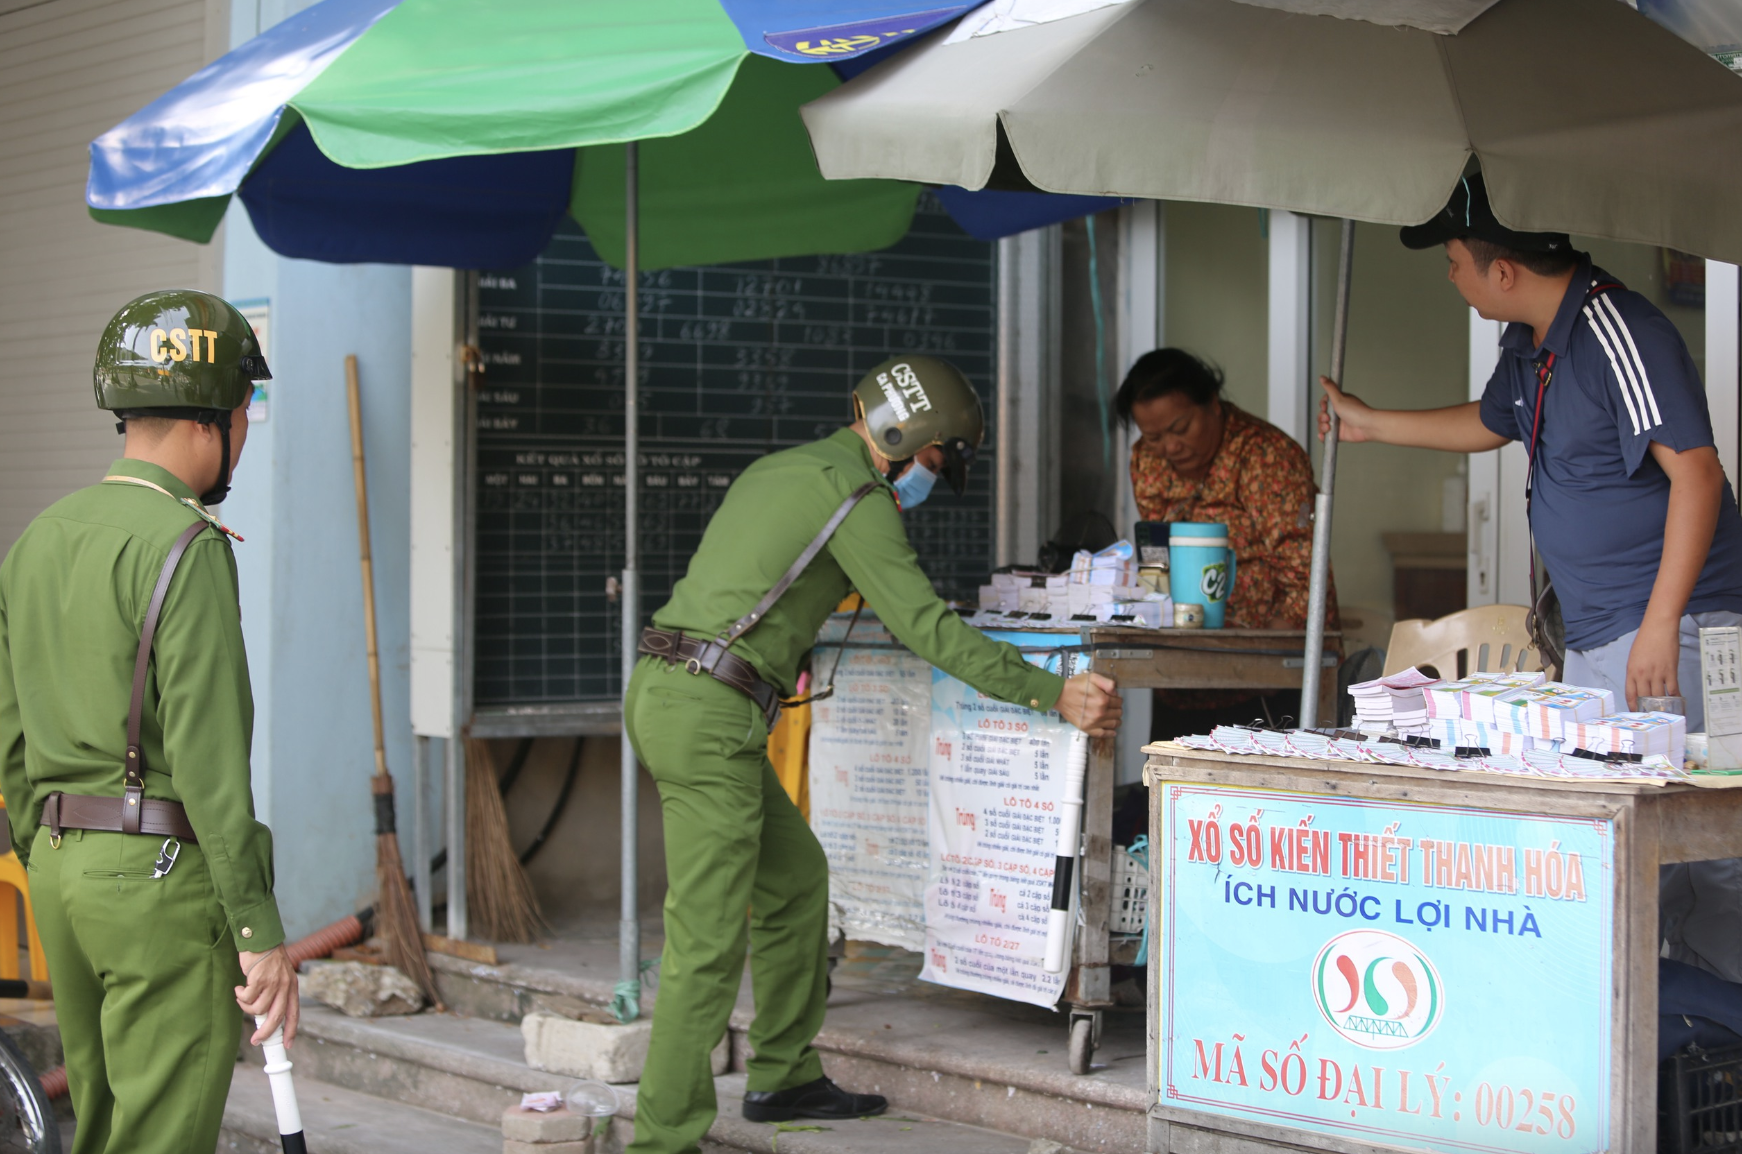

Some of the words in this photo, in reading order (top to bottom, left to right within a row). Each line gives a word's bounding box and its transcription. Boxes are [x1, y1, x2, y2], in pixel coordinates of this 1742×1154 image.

[150, 328, 218, 363] CSTT
[891, 363, 932, 413] CSTT
[1202, 568, 1226, 599] C2
[978, 718, 990, 729] LÔ
[993, 719, 1006, 730] TÔ
[1007, 721, 1013, 730] 3
[1003, 796, 1017, 806] LÔ
[1019, 798, 1032, 809] TÔ
[1034, 801, 1040, 809] 4
[1188, 804, 1222, 863] XỔ
[1229, 809, 1263, 868] SỐ
[1270, 815, 1331, 875] KIẾN
[1338, 822, 1413, 883] THIẾT
[1419, 839, 1516, 894] THANH
[1524, 841, 1586, 901] HÓA
[1225, 874, 1275, 908] ÍCH
[1289, 887, 1381, 920] NƯỚC
[1395, 899, 1450, 932] LỢI
[1465, 905, 1542, 938] NHÀ
[975, 934, 988, 944] LÔ
[990, 936, 1001, 947] TÔ
[1191, 1033, 1249, 1087] MÃ
[1259, 1033, 1309, 1096] SỐ
[1317, 1058, 1385, 1118] ĐẠI
[1475, 1081, 1576, 1139] 00258
